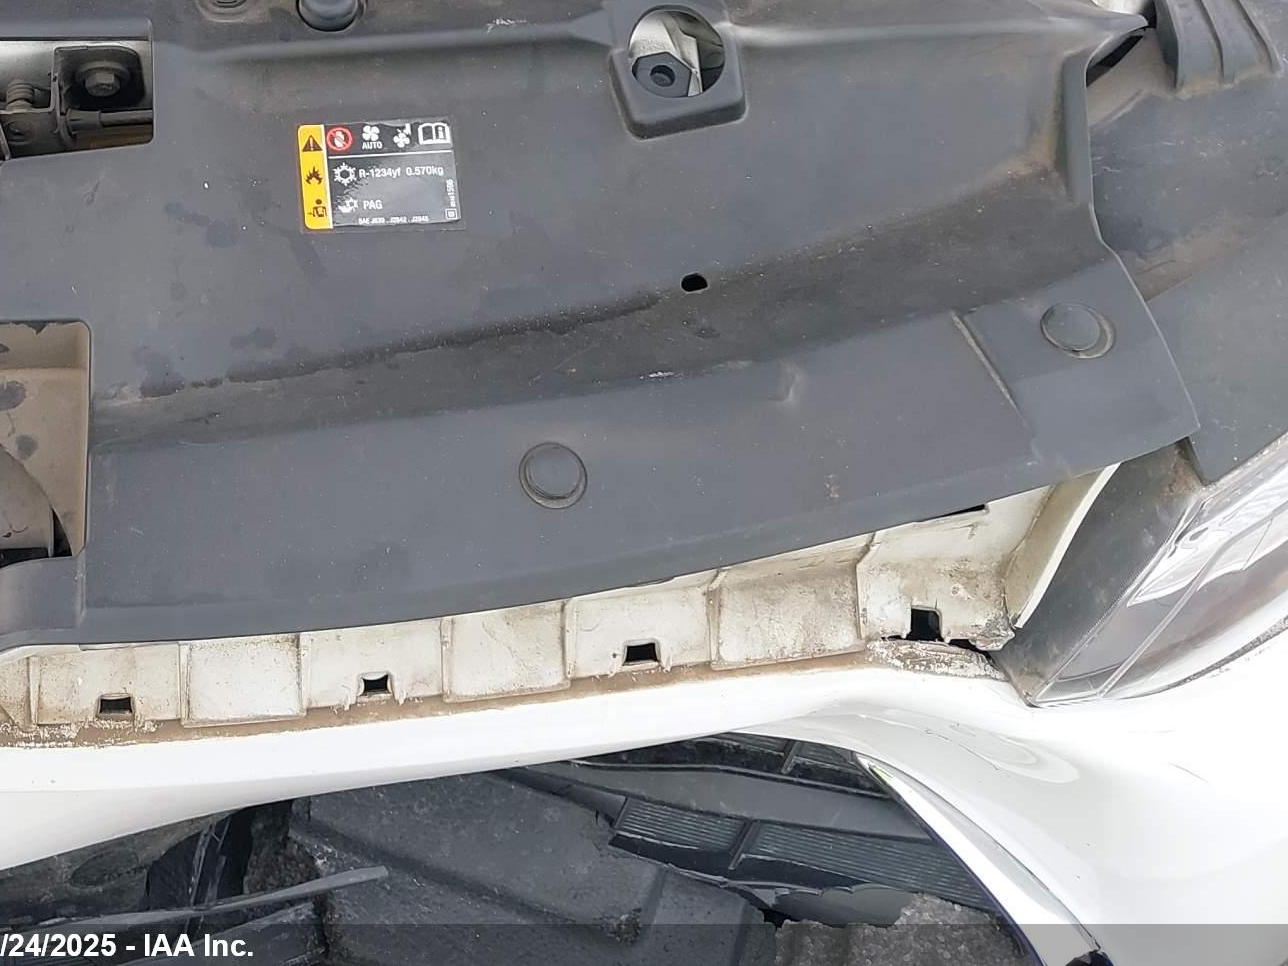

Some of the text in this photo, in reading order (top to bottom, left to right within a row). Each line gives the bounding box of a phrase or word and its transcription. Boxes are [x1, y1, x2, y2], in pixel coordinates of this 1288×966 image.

[362, 141, 383, 150] AUTO
[358, 165, 444, 179] R-1234yf 0.570kg
[363, 199, 383, 210] PAG
